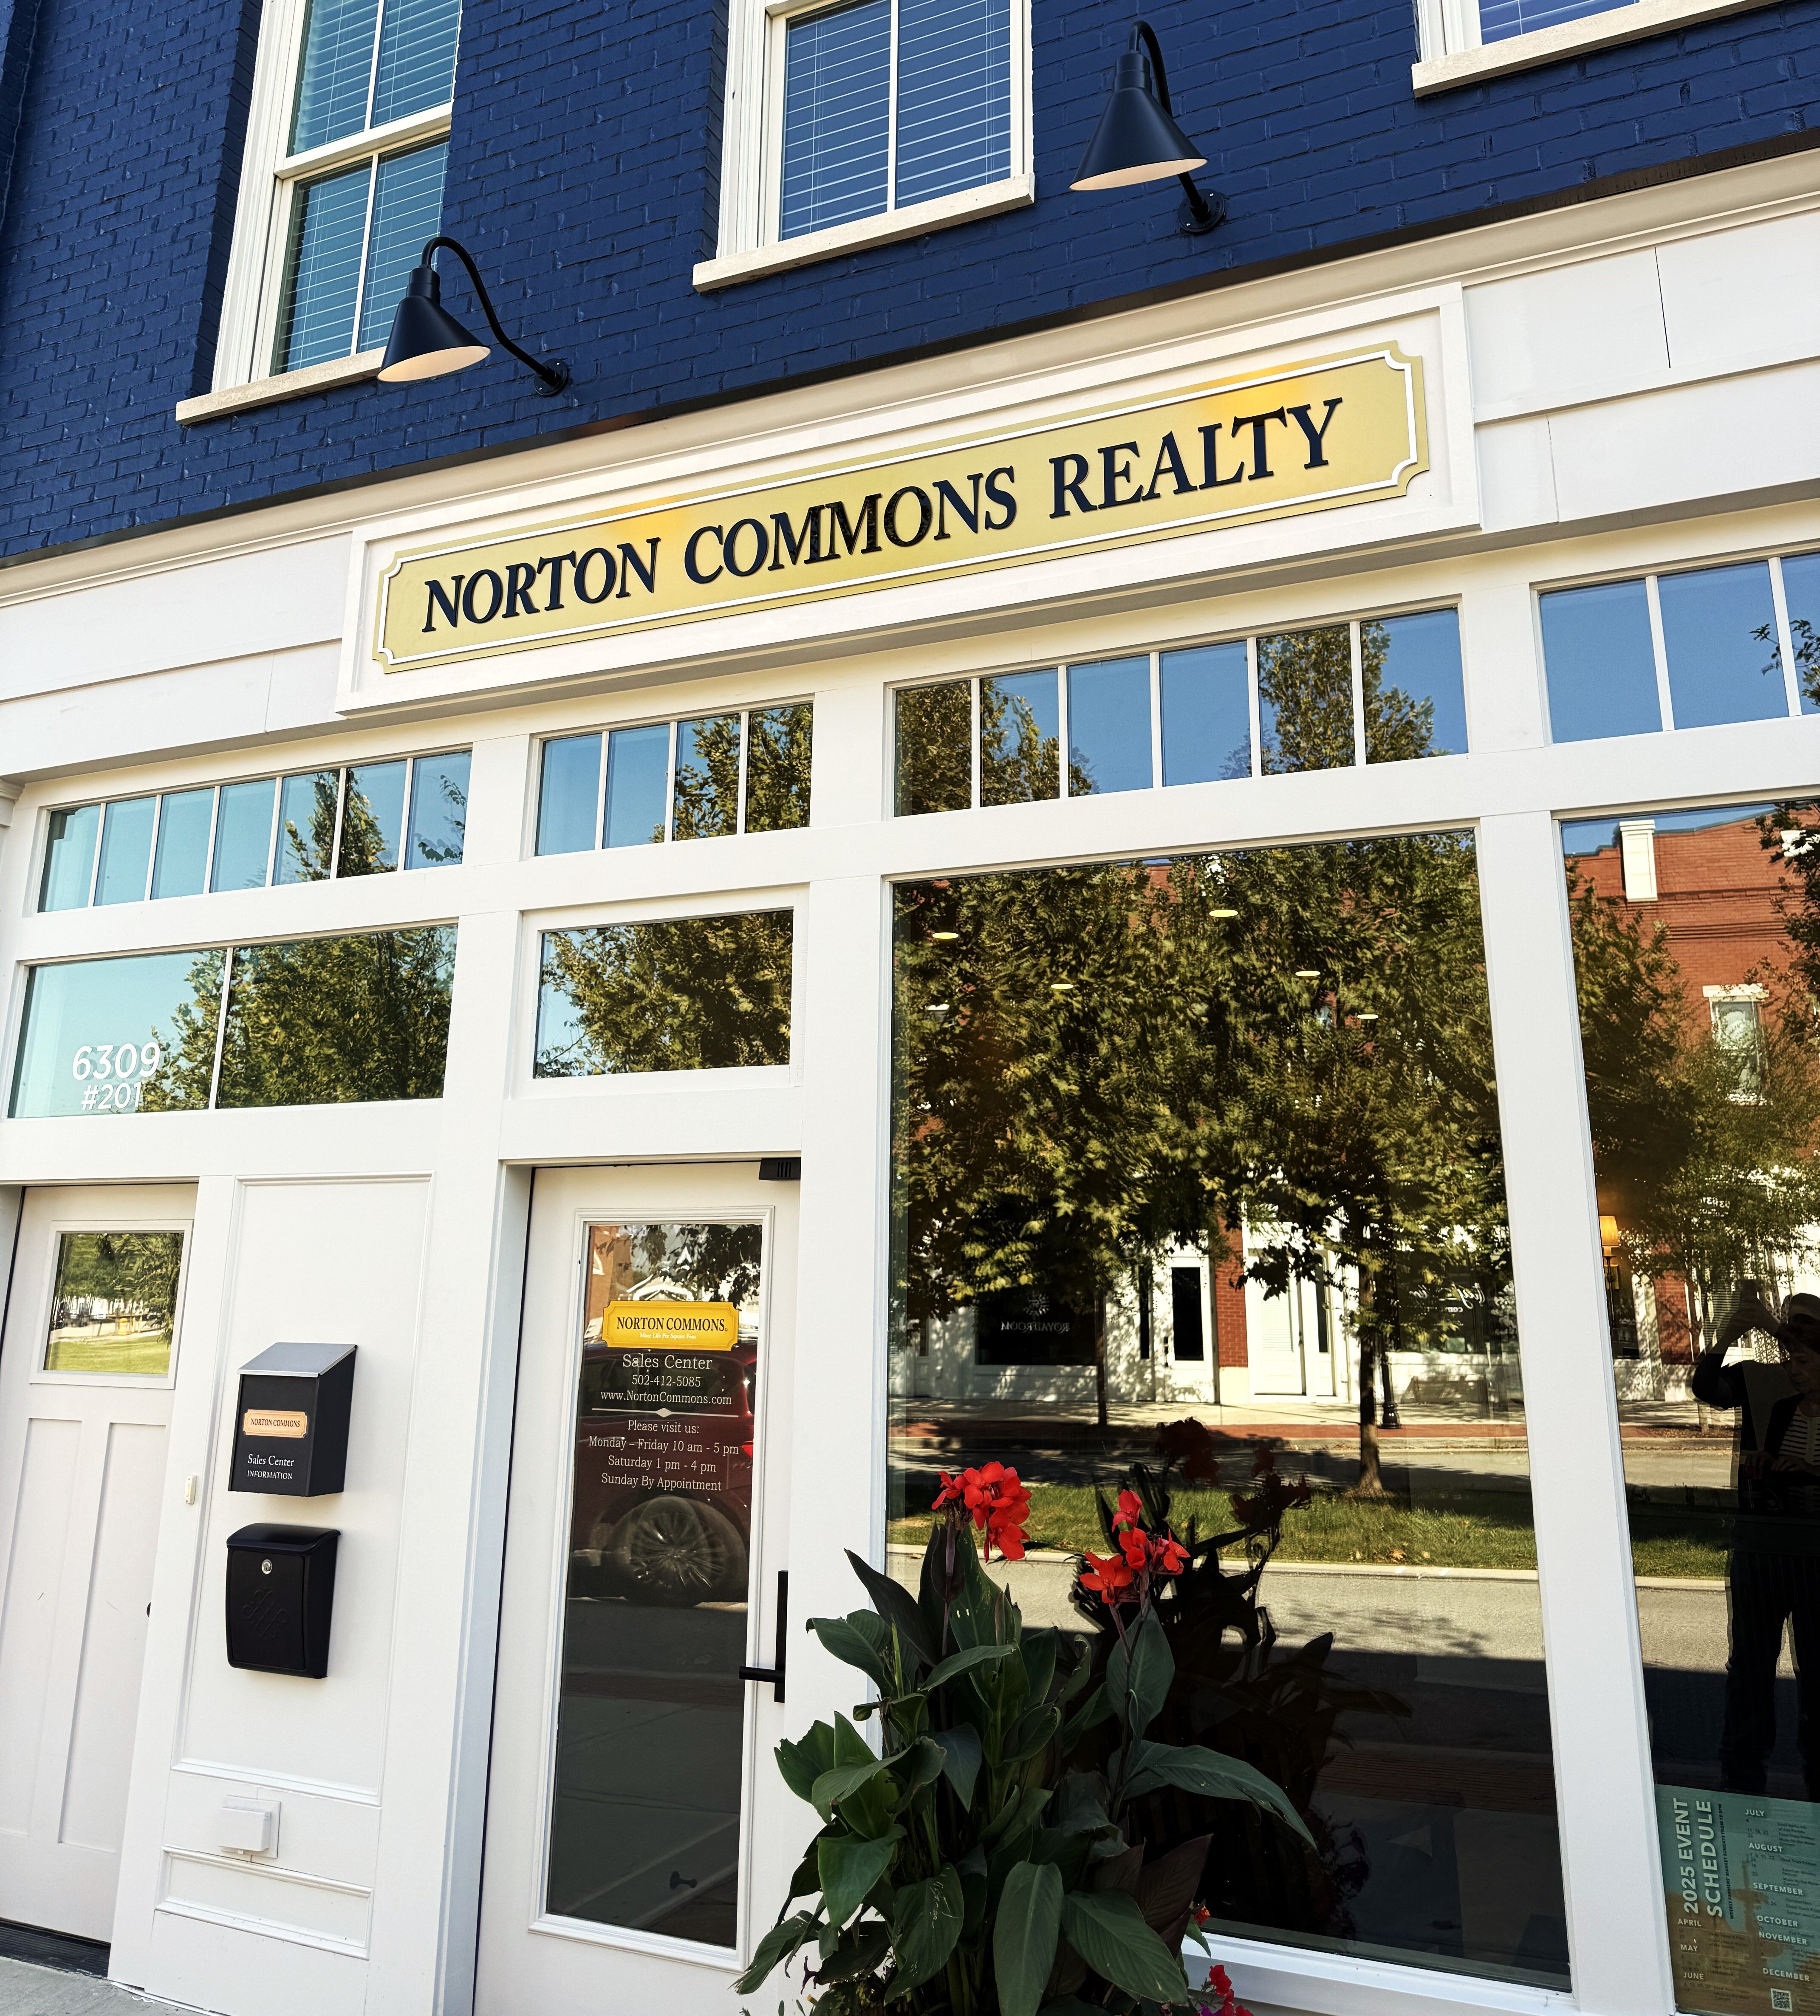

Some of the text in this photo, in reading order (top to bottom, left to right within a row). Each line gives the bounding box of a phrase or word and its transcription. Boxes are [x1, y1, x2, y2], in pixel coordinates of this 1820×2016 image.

[422, 397, 1343, 633] NORTON COMMONS REALTY
[72, 1042, 161, 1080] 6309
[81, 1081, 141, 1110] #201
[616, 1317, 725, 1331] NORTON COMMONS
[623, 1353, 712, 1369] Sales Center
[632, 1375, 701, 1386] 502-412-5085
[601, 1390, 732, 1405] www.NortonCommons.com
[628, 1420, 699, 1434] Please visit us:
[589, 1436, 626, 1451] Monday
[638, 1439, 669, 1452] Friday
[673, 1440, 684, 1451] 10
[687, 1444, 702, 1452] am
[714, 1442, 720, 1453] 5
[723, 1445, 739, 1457] pm
[248, 1454, 294, 1466] Sales Center
[608, 1455, 652, 1471] Saturday
[656, 1458, 660, 1468] 1
[665, 1460, 680, 1471] pm
[691, 1460, 697, 1470] 4
[701, 1463, 716, 1474] pm
[247, 1470, 292, 1479] INFORMATION
[602, 1473, 722, 1492] Sunday By Appointment
[1745, 1809, 1765, 1817] JULY
[1749, 1842, 1783, 1852] AUGUST
[1673, 1798, 1699, 1914] 2025 EVENT
[1696, 1801, 1723, 1917] SCHEDULE
[1753, 1883, 1803, 1895] SEPTEMBER
[1678, 1918, 1701, 1927] APRIL
[1757, 1915, 1797, 1927] OCTOBER
[1759, 1931, 1807, 1945] NOVEMBER
[1763, 1968, 1809, 1982] DECEMBER
